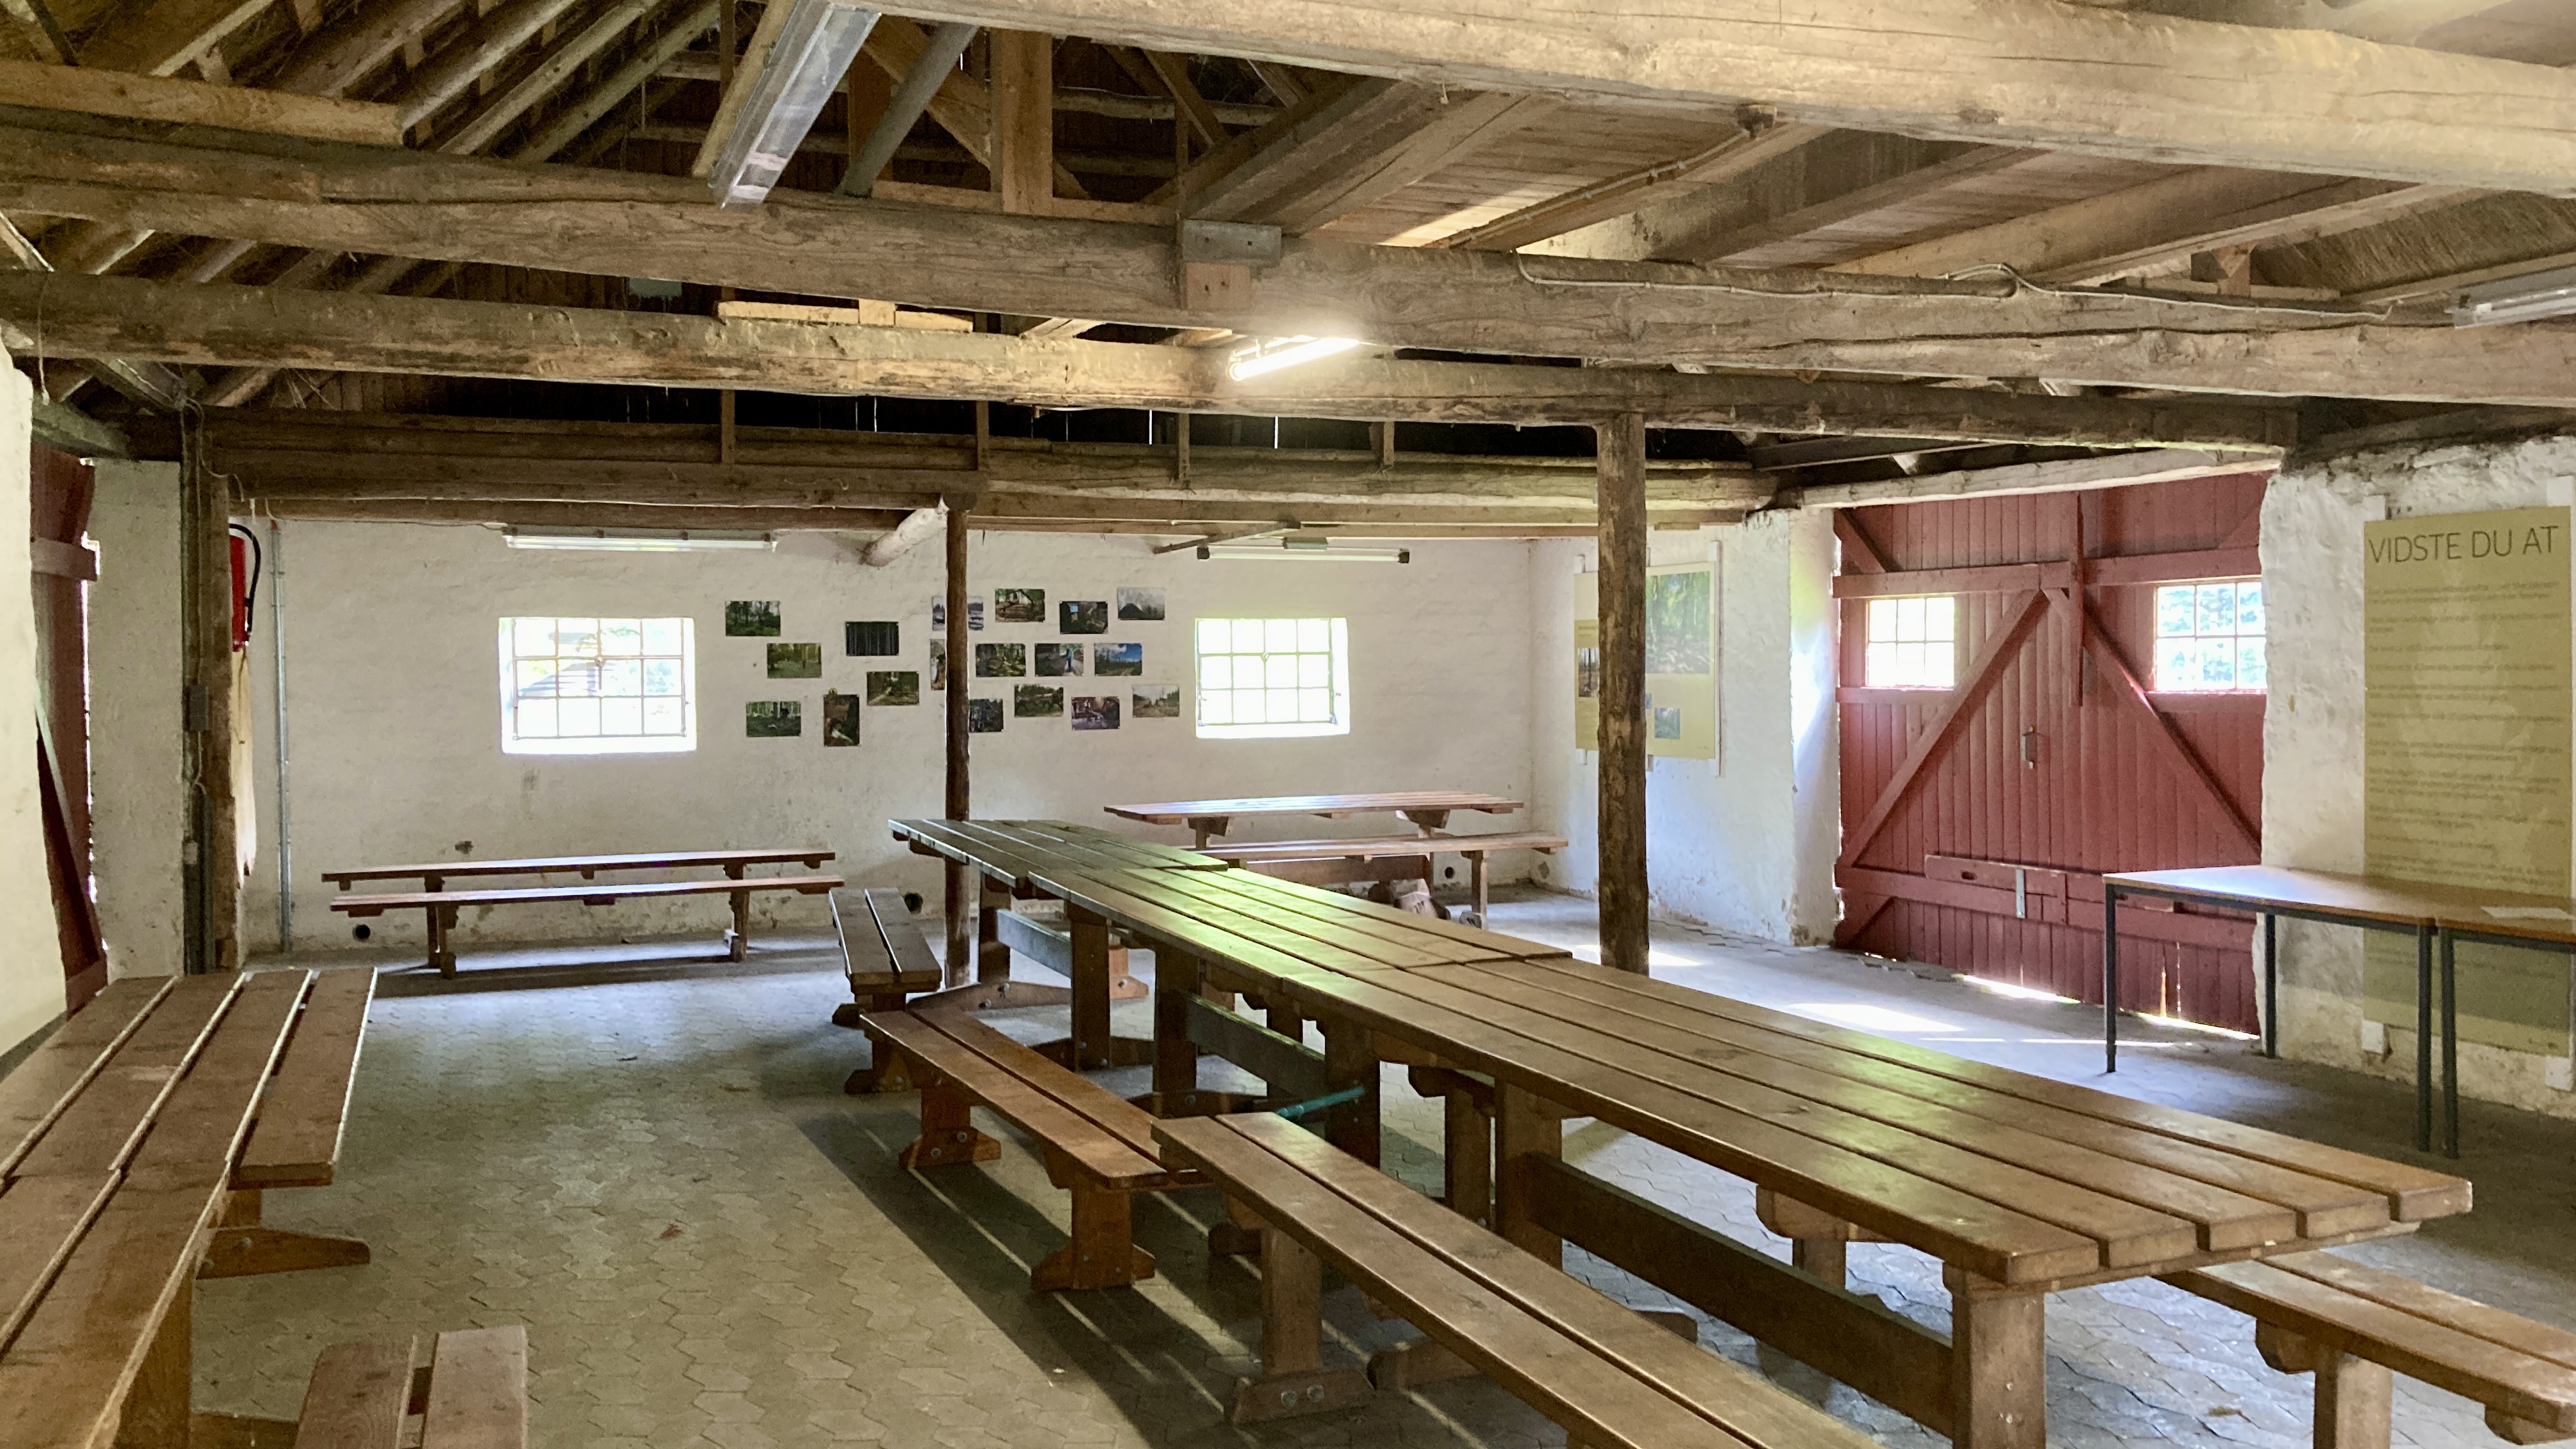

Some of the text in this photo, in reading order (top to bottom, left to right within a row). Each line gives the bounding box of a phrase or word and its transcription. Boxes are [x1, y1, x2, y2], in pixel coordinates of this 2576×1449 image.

[2368, 525, 2559, 563] VIDSTE DU AT
